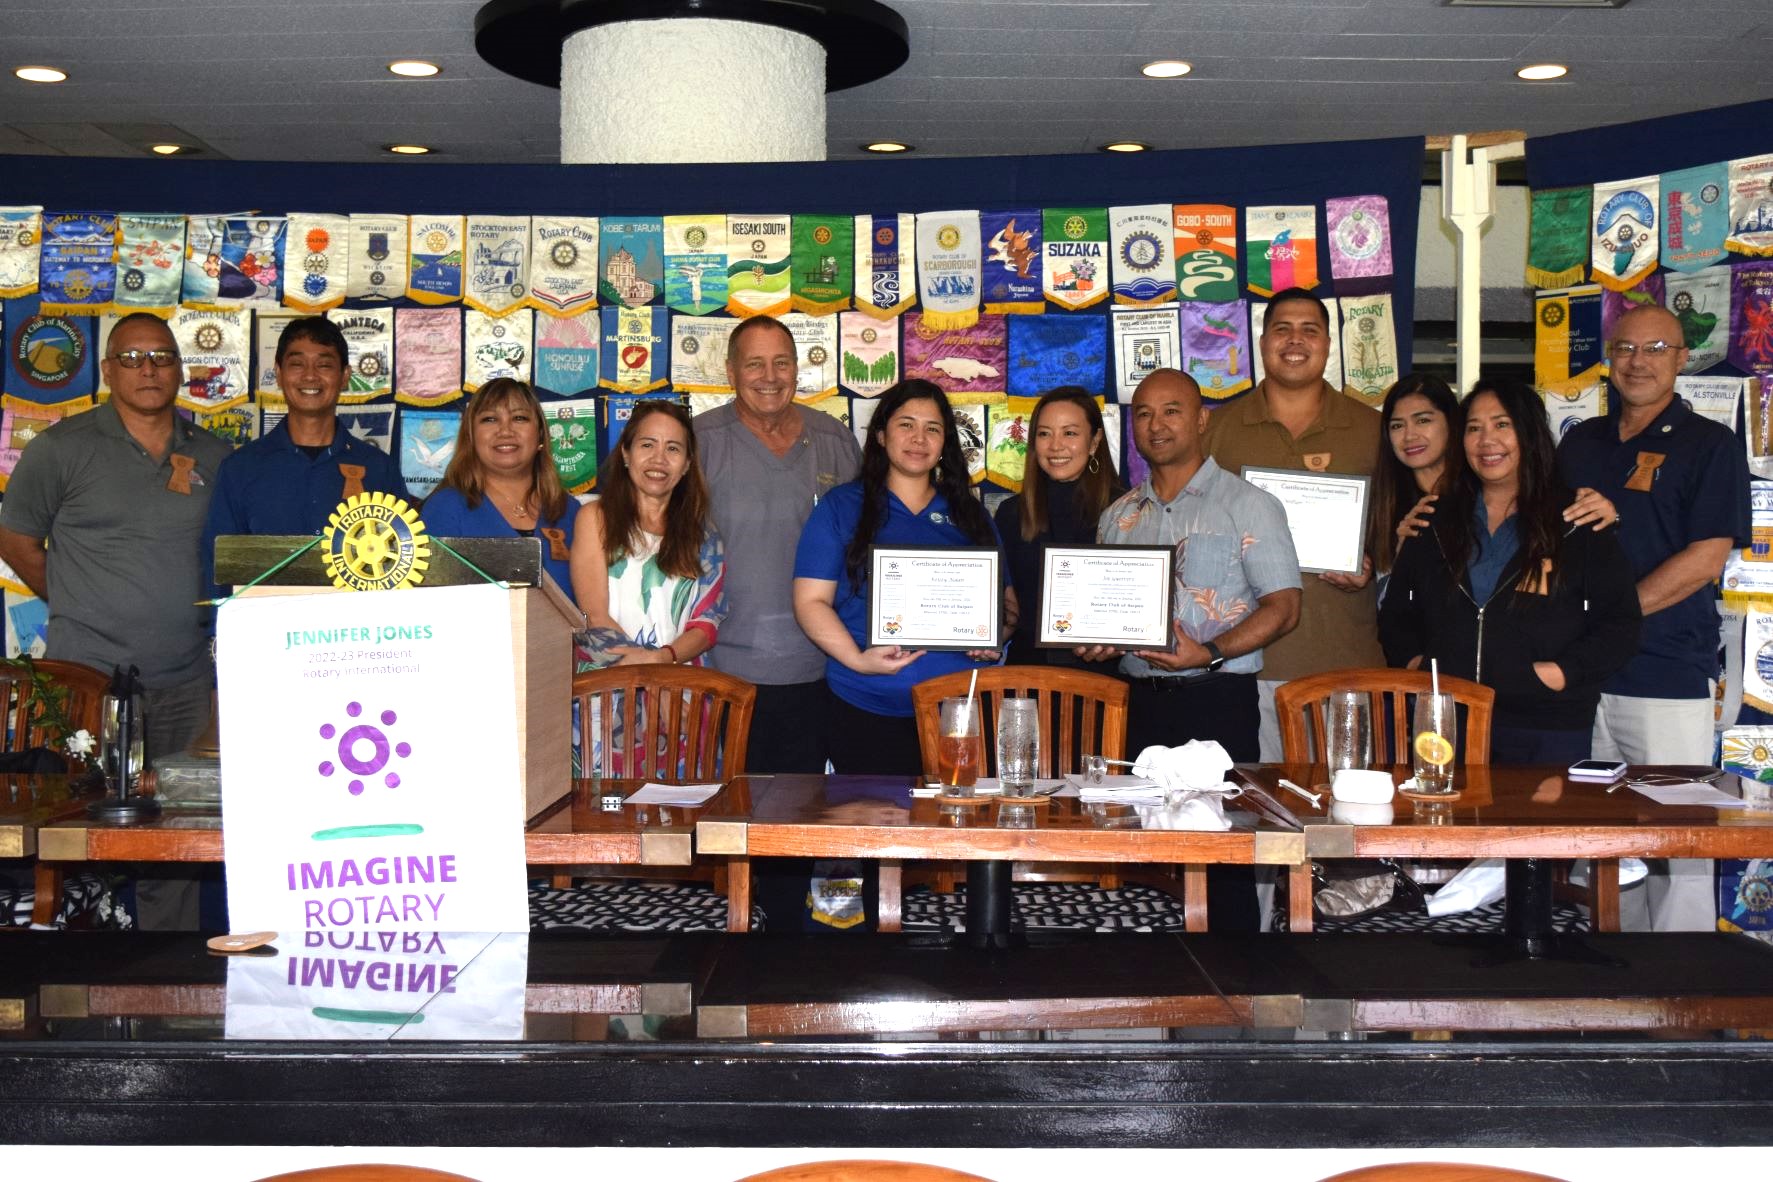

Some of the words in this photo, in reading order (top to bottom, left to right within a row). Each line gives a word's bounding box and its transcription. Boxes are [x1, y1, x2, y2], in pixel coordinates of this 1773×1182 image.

[1599, 193, 1626, 226] ROTARY
[1628, 193, 1649, 211] CLUB
[470, 224, 508, 232] STOCKTON
[508, 224, 527, 232] EAST
[538, 227, 570, 241] ROTARY
[572, 225, 593, 243] CLUB
[603, 223, 625, 233] KOBE
[633, 223, 661, 233] TARUMI
[732, 223, 761, 236] ISESAKI
[762, 223, 786, 235] SOUTH
[470, 231, 500, 239] ROTARY
[750, 252, 768, 260] JAPAN
[1049, 243, 1101, 257] SUZAKA
[924, 259, 977, 271] SCARBOROUGH
[1349, 303, 1385, 321] ROTARY
[605, 334, 662, 344] MARTINSBURG
[1573, 344, 1591, 352] Club
[544, 353, 590, 364] HONOLULU
[550, 362, 584, 372] SUNRISE
[30, 370, 69, 382] SINGAPORE
[1693, 391, 1736, 400] ALSTONVILLE
[560, 464, 577, 473] WEST
[341, 505, 393, 530] ROTARY
[333, 543, 414, 592] INTERNATIONAL
[911, 560, 941, 568] Certificate
[952, 626, 975, 635] Rotary
[1122, 625, 1145, 634] Rotary
[285, 626, 371, 650] JENNIFER
[375, 624, 433, 645] JONES
[308, 650, 354, 664] 2022-23
[357, 648, 412, 660] President
[302, 668, 341, 680] Rotary
[287, 854, 458, 891] IMAGINE
[304, 892, 446, 929] ROTARY
